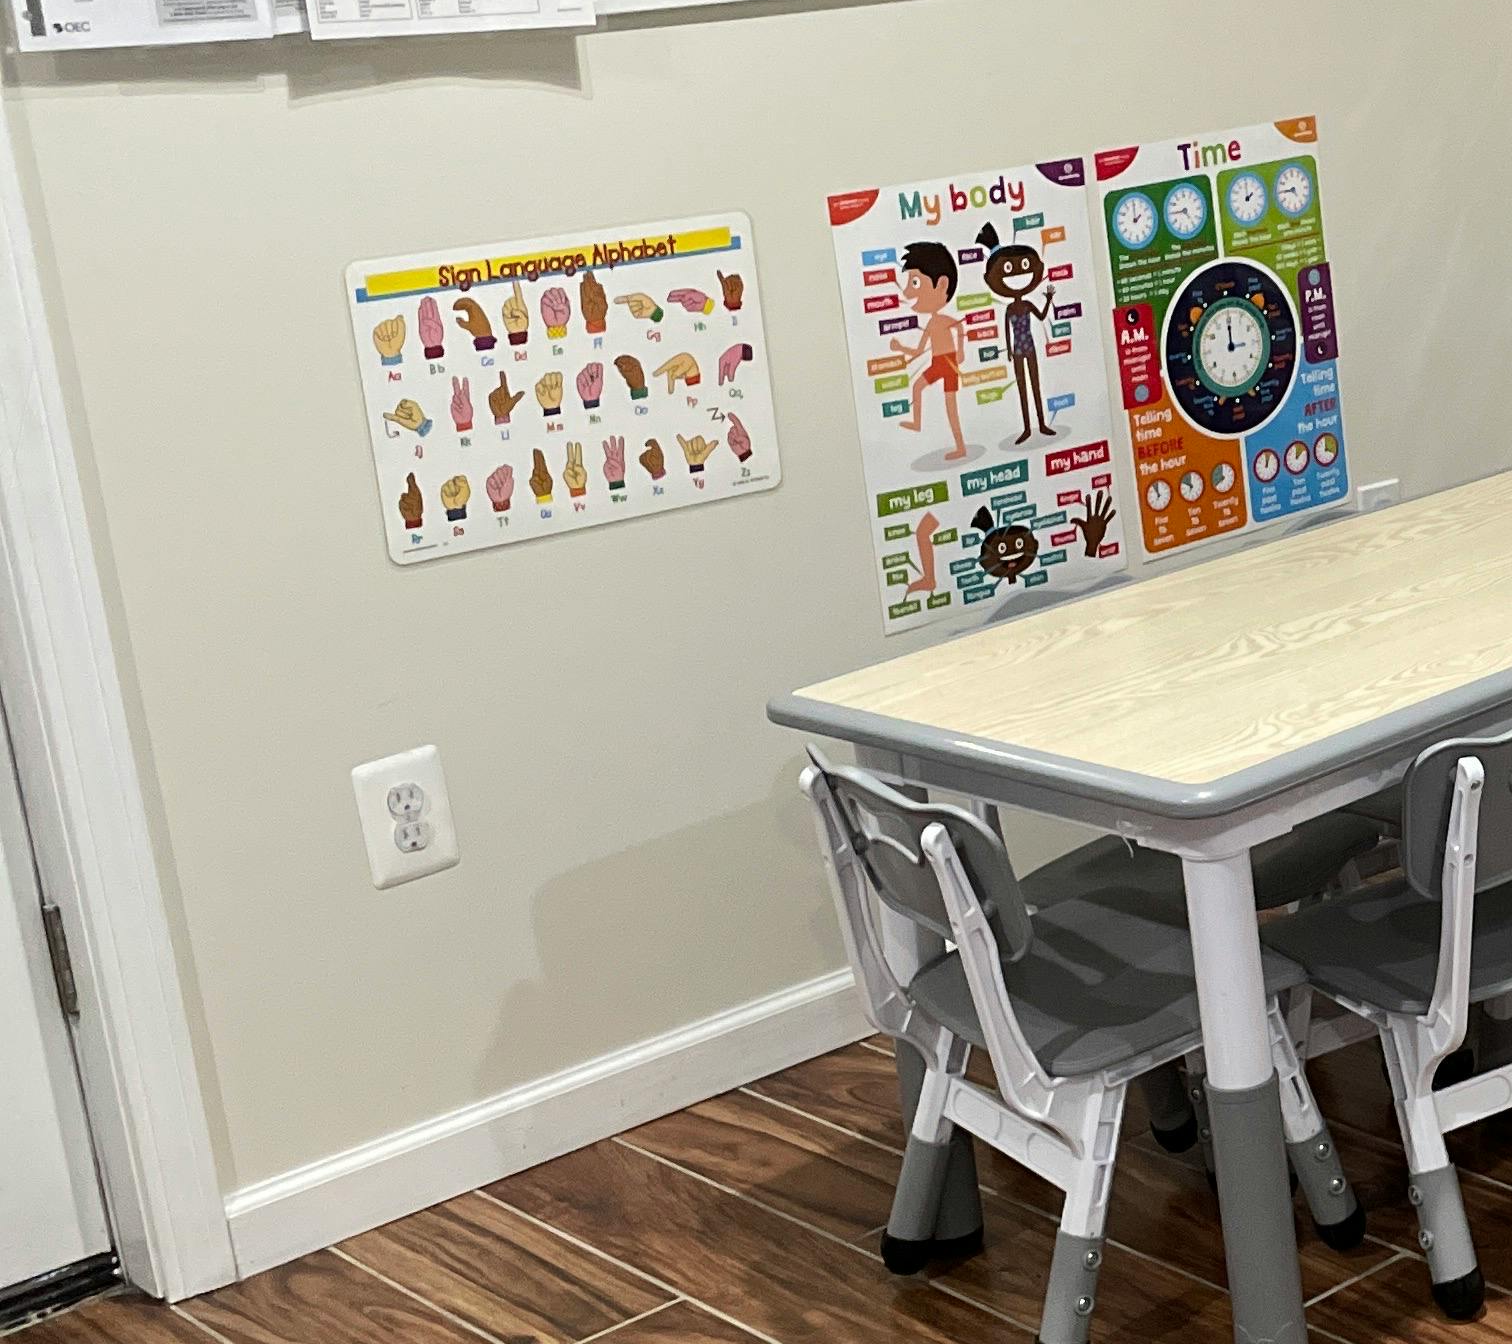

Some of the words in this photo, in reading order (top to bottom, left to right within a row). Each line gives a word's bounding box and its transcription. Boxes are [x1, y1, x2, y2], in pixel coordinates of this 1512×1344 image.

[1177, 139, 1242, 171] Time
[899, 191, 941, 226] My
[949, 176, 1025, 213] body
[438, 264, 481, 292] Sign
[485, 253, 586, 282] Language
[592, 234, 676, 270] Alphabet
[1305, 287, 1326, 304] P.M.
[1121, 327, 1149, 346] A.M.
[1051, 457, 1071, 470] my
[1073, 447, 1104, 463] hand
[967, 477, 988, 492] my
[990, 468, 1021, 485] head
[889, 495, 911, 511] my
[913, 487, 935, 505] leg
